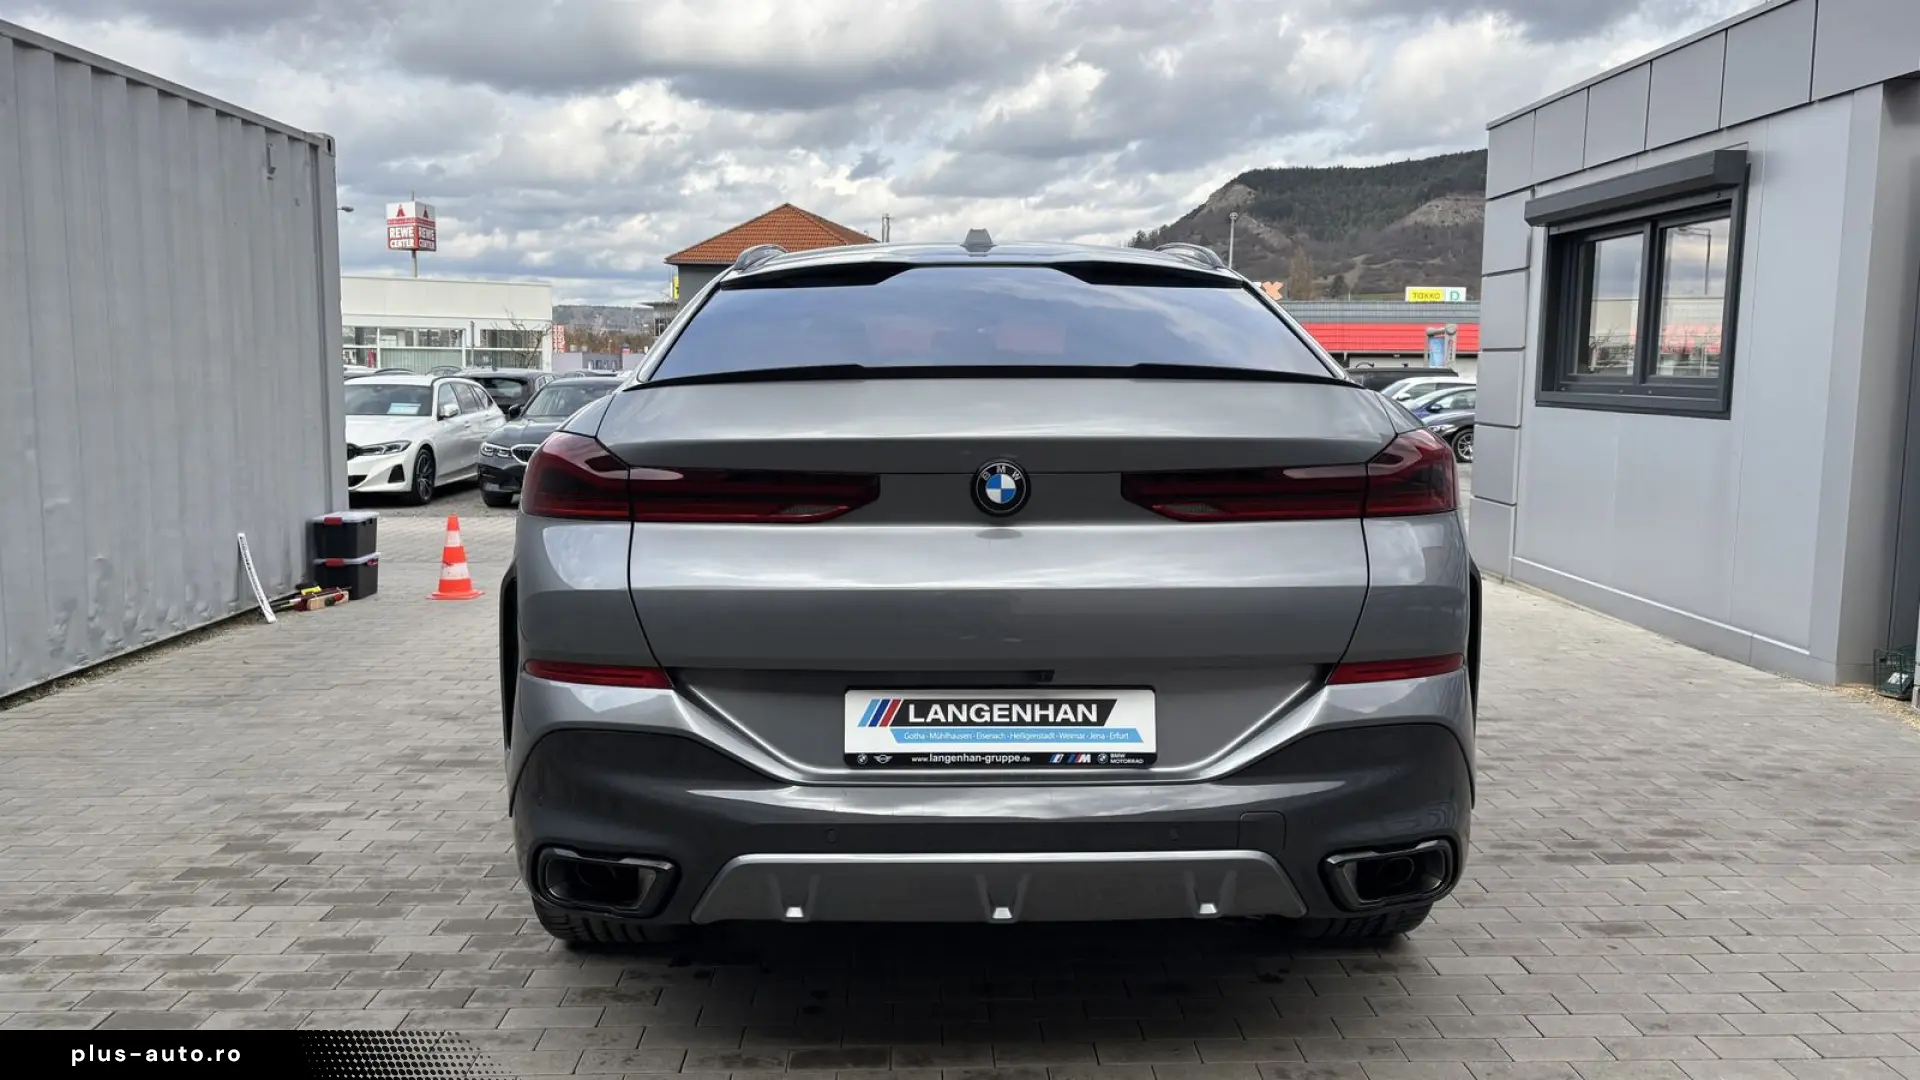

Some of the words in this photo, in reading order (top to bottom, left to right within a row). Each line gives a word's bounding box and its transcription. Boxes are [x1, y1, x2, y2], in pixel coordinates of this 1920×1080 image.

[390, 226, 415, 239] REWE
[390, 239, 415, 249] CENTER
[981, 465, 1022, 481] BMW
[908, 703, 1098, 723] LANGENHAN
[903, 731, 926, 740] Gotha
[929, 731, 972, 740] Mühlhausen
[1109, 731, 1129, 740] Erfurt
[911, 753, 1031, 764] www.langenhan-gruppe.de
